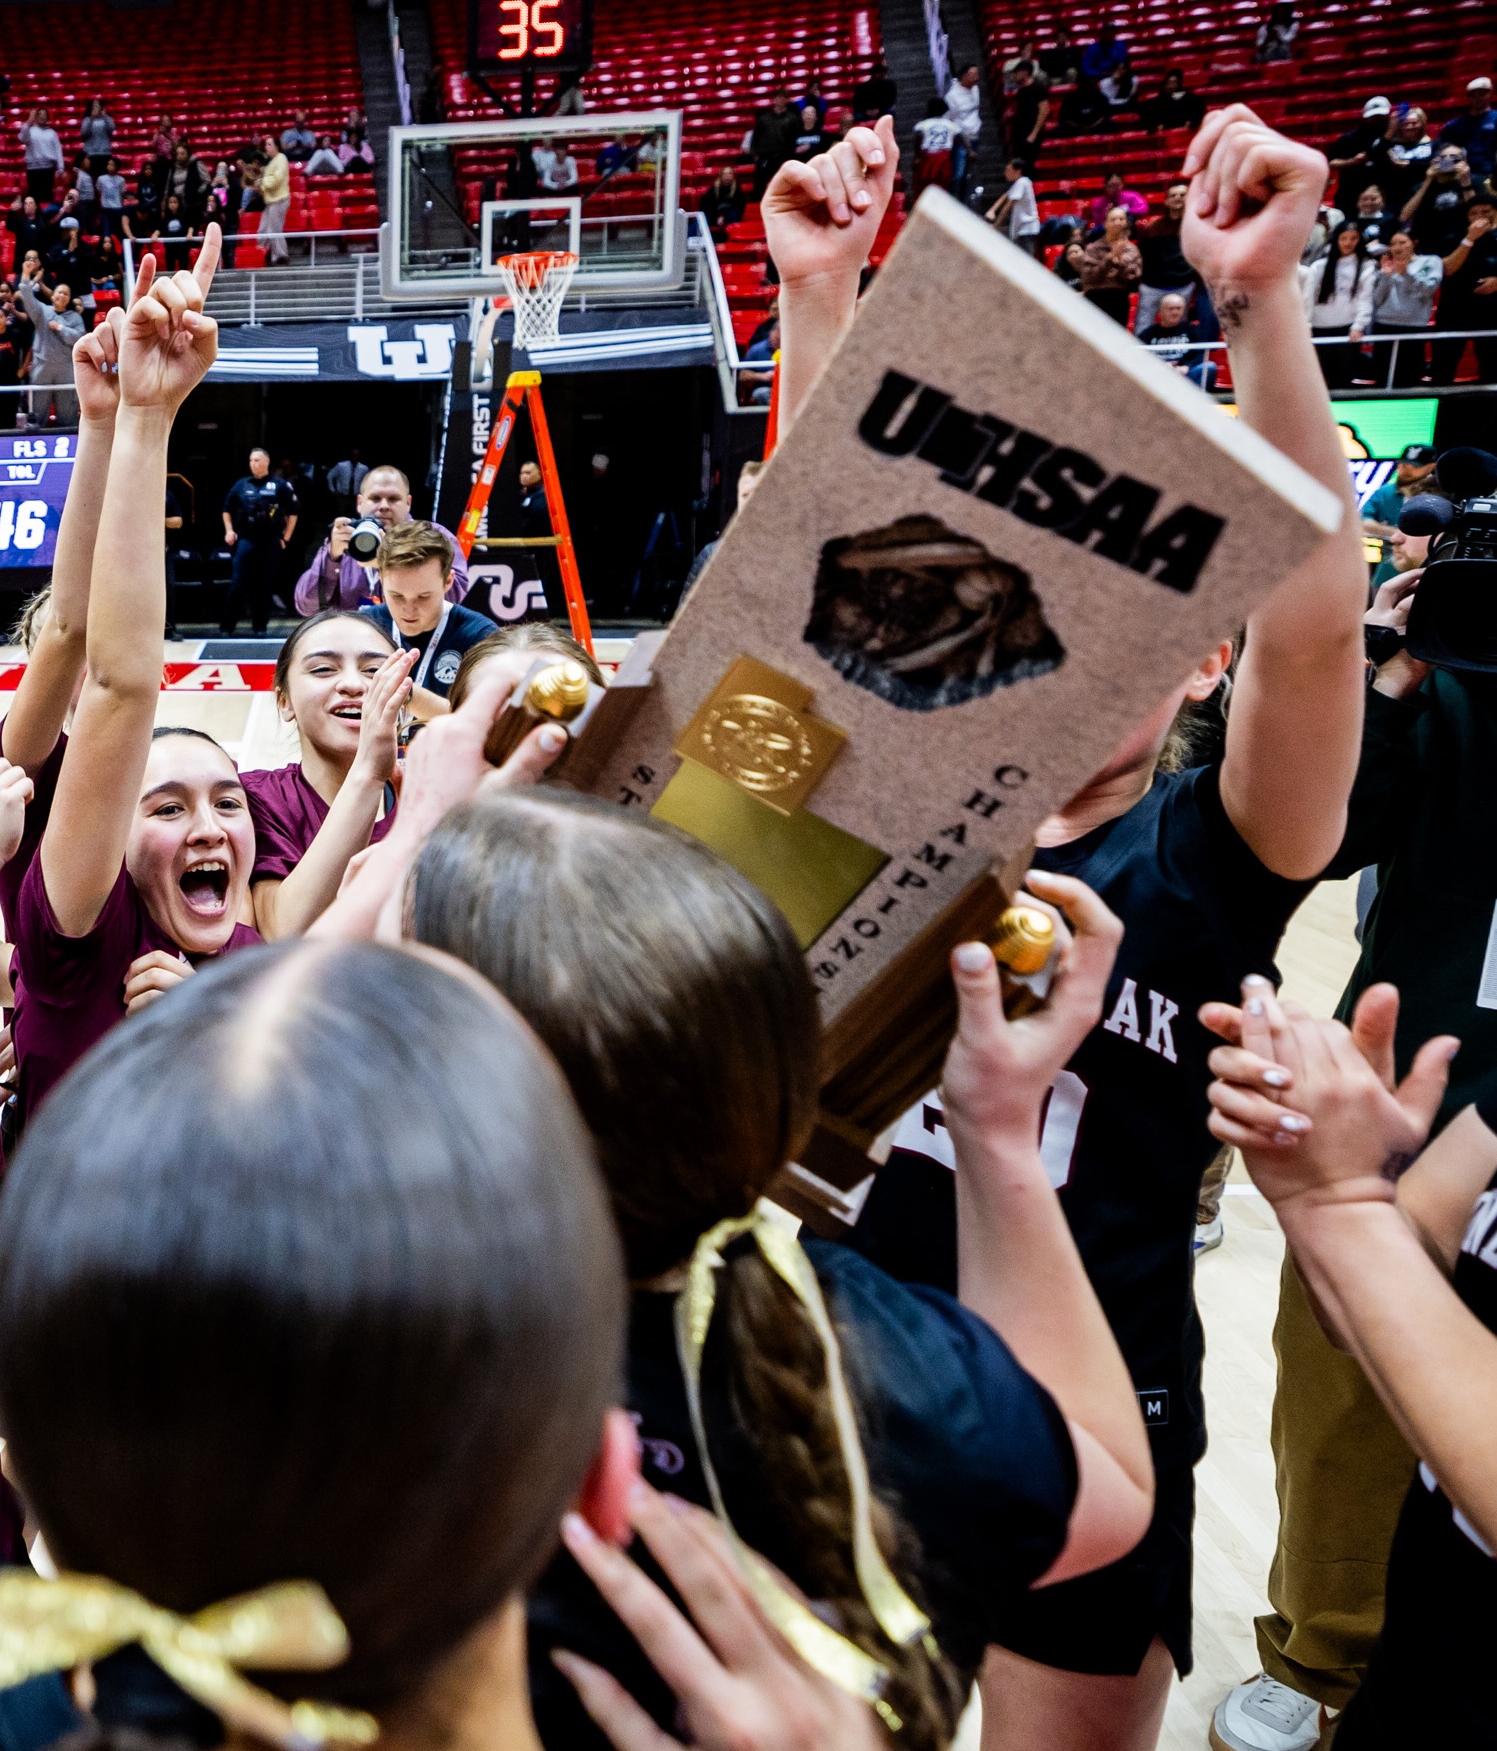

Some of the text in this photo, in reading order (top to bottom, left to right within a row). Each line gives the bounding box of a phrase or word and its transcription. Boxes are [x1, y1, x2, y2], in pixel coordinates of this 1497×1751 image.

[497, 0, 564, 59] 35
[13, 437, 70, 458] FLS 2
[472, 394, 491, 455] FIRST
[7, 465, 36, 479] TOL
[814, 764, 1029, 980] CHAMPIONS
[1103, 977, 1179, 1064] AK
[1147, 1400, 1162, 1416] M
